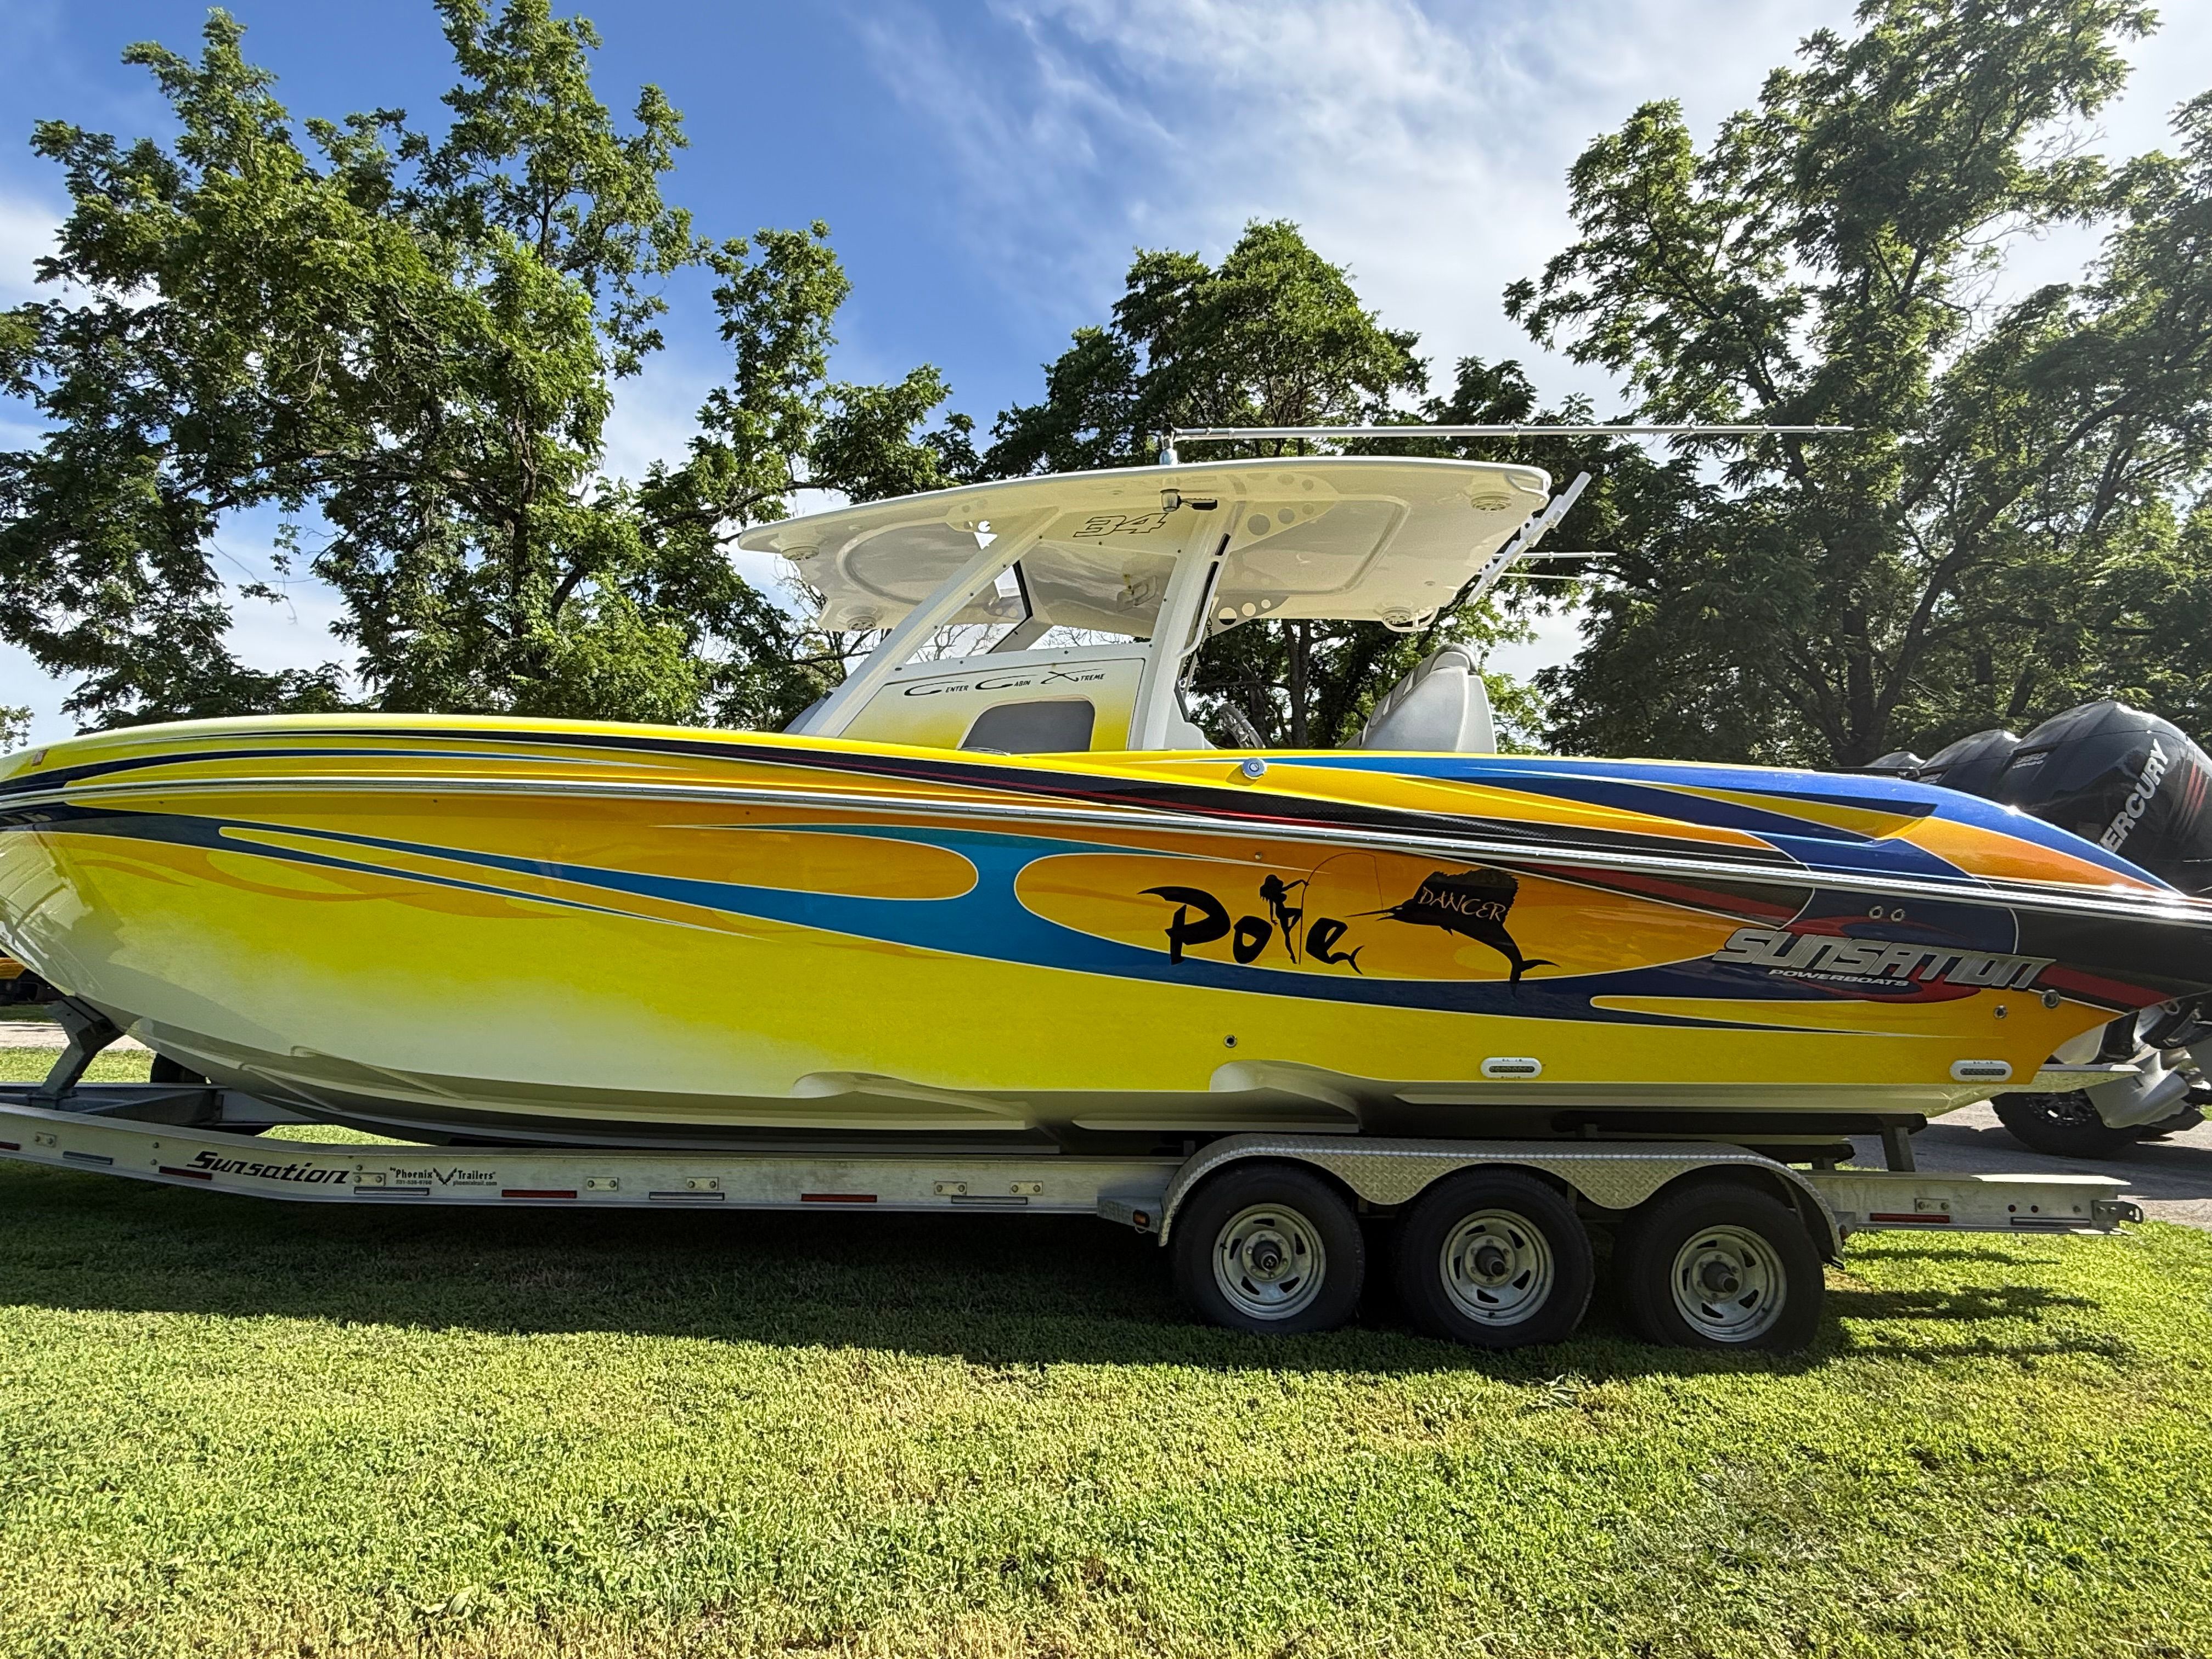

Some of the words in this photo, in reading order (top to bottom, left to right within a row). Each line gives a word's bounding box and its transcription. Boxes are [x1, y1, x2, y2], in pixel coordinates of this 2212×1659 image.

[1073, 512, 1169, 538] 34
[904, 681, 969, 696] CENTER
[975, 674, 1037, 690] CABIN
[1041, 668, 1105, 685] XTREME
[2098, 738, 2168, 853] ERCURY
[1417, 887, 1506, 922] DANCER
[1769, 968, 1910, 987] POWERBOATS
[187, 1150, 350, 1184] Sunsation
[396, 1169, 433, 1179] Phoenix
[458, 1170, 494, 1180] Trailers
